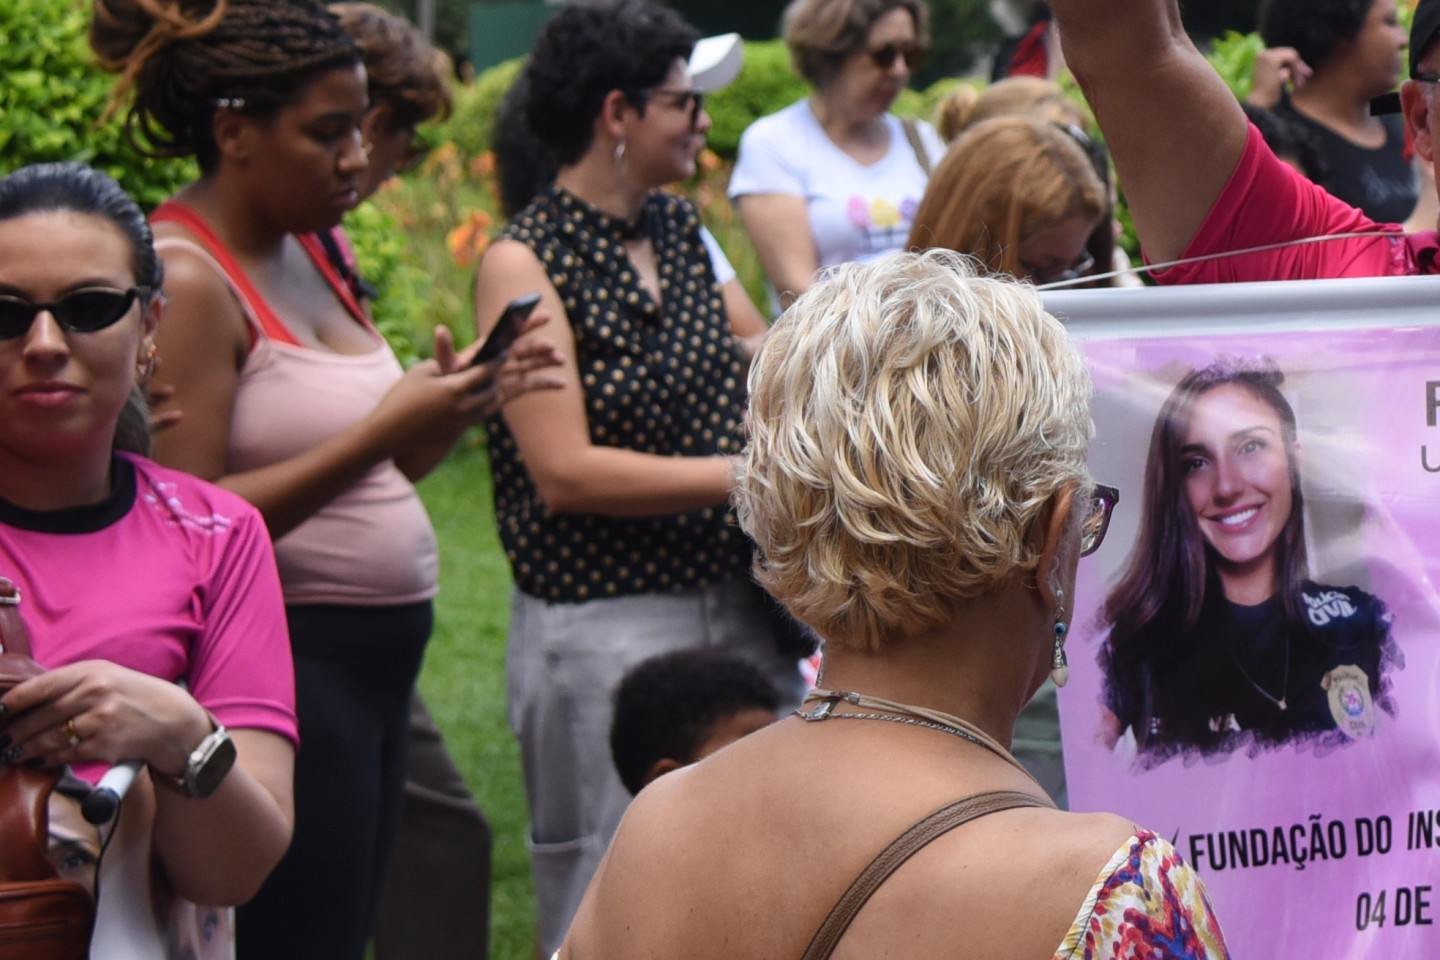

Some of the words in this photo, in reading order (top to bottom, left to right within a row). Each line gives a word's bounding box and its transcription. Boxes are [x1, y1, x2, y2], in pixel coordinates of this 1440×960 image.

[1189, 814, 1347, 871] FUNDAÇÃO
[1355, 815, 1392, 857] DO
[1355, 890, 1386, 931] 04
[1394, 885, 1433, 927] DE
